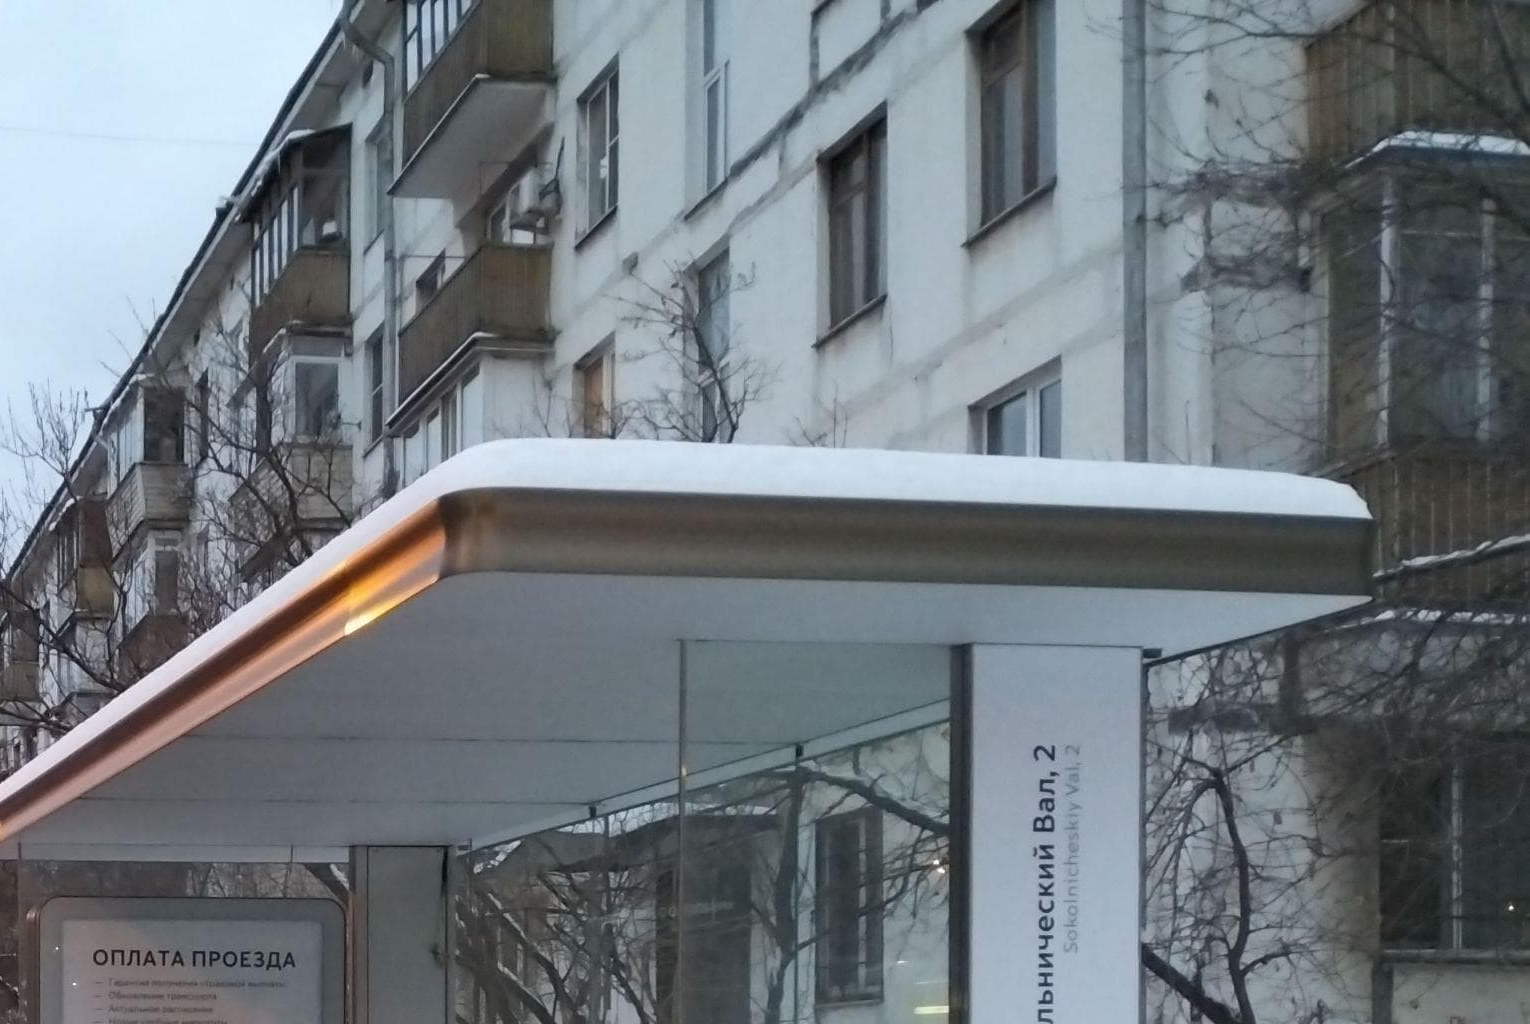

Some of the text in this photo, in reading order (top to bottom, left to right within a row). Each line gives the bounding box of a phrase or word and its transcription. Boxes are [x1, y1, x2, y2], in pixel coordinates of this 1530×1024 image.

[1032, 744, 1056, 761] 2
[1065, 744, 1080, 755] 2
[1032, 771, 1060, 832] Вал,
[1063, 802, 1083, 954] Sokolnicheskiy
[92, 949, 297, 971] ОПЛАТА ПРОЕЗДА
